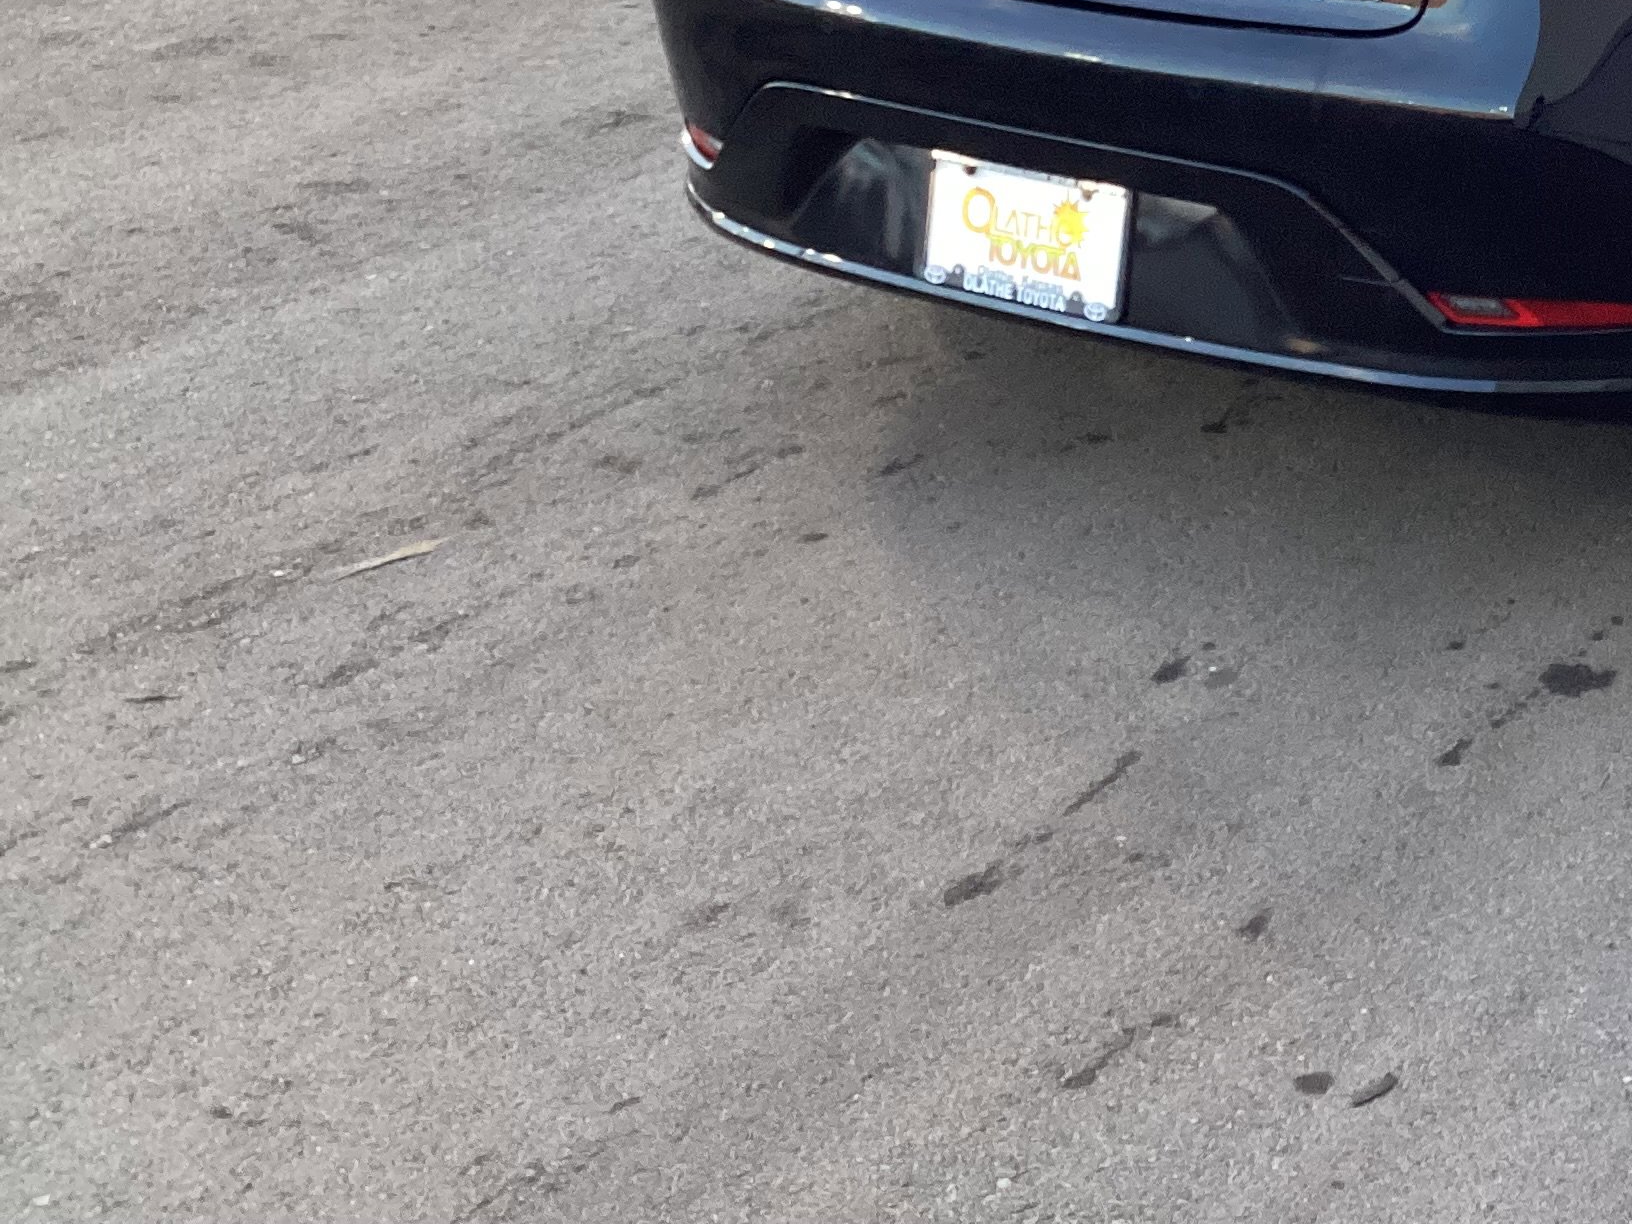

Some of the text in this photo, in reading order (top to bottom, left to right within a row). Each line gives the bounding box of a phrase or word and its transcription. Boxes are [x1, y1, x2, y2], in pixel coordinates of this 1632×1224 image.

[989, 234, 1081, 281] TOYOTA
[963, 273, 1014, 300] OLATHE
[1017, 285, 1067, 313] TOYOTA
